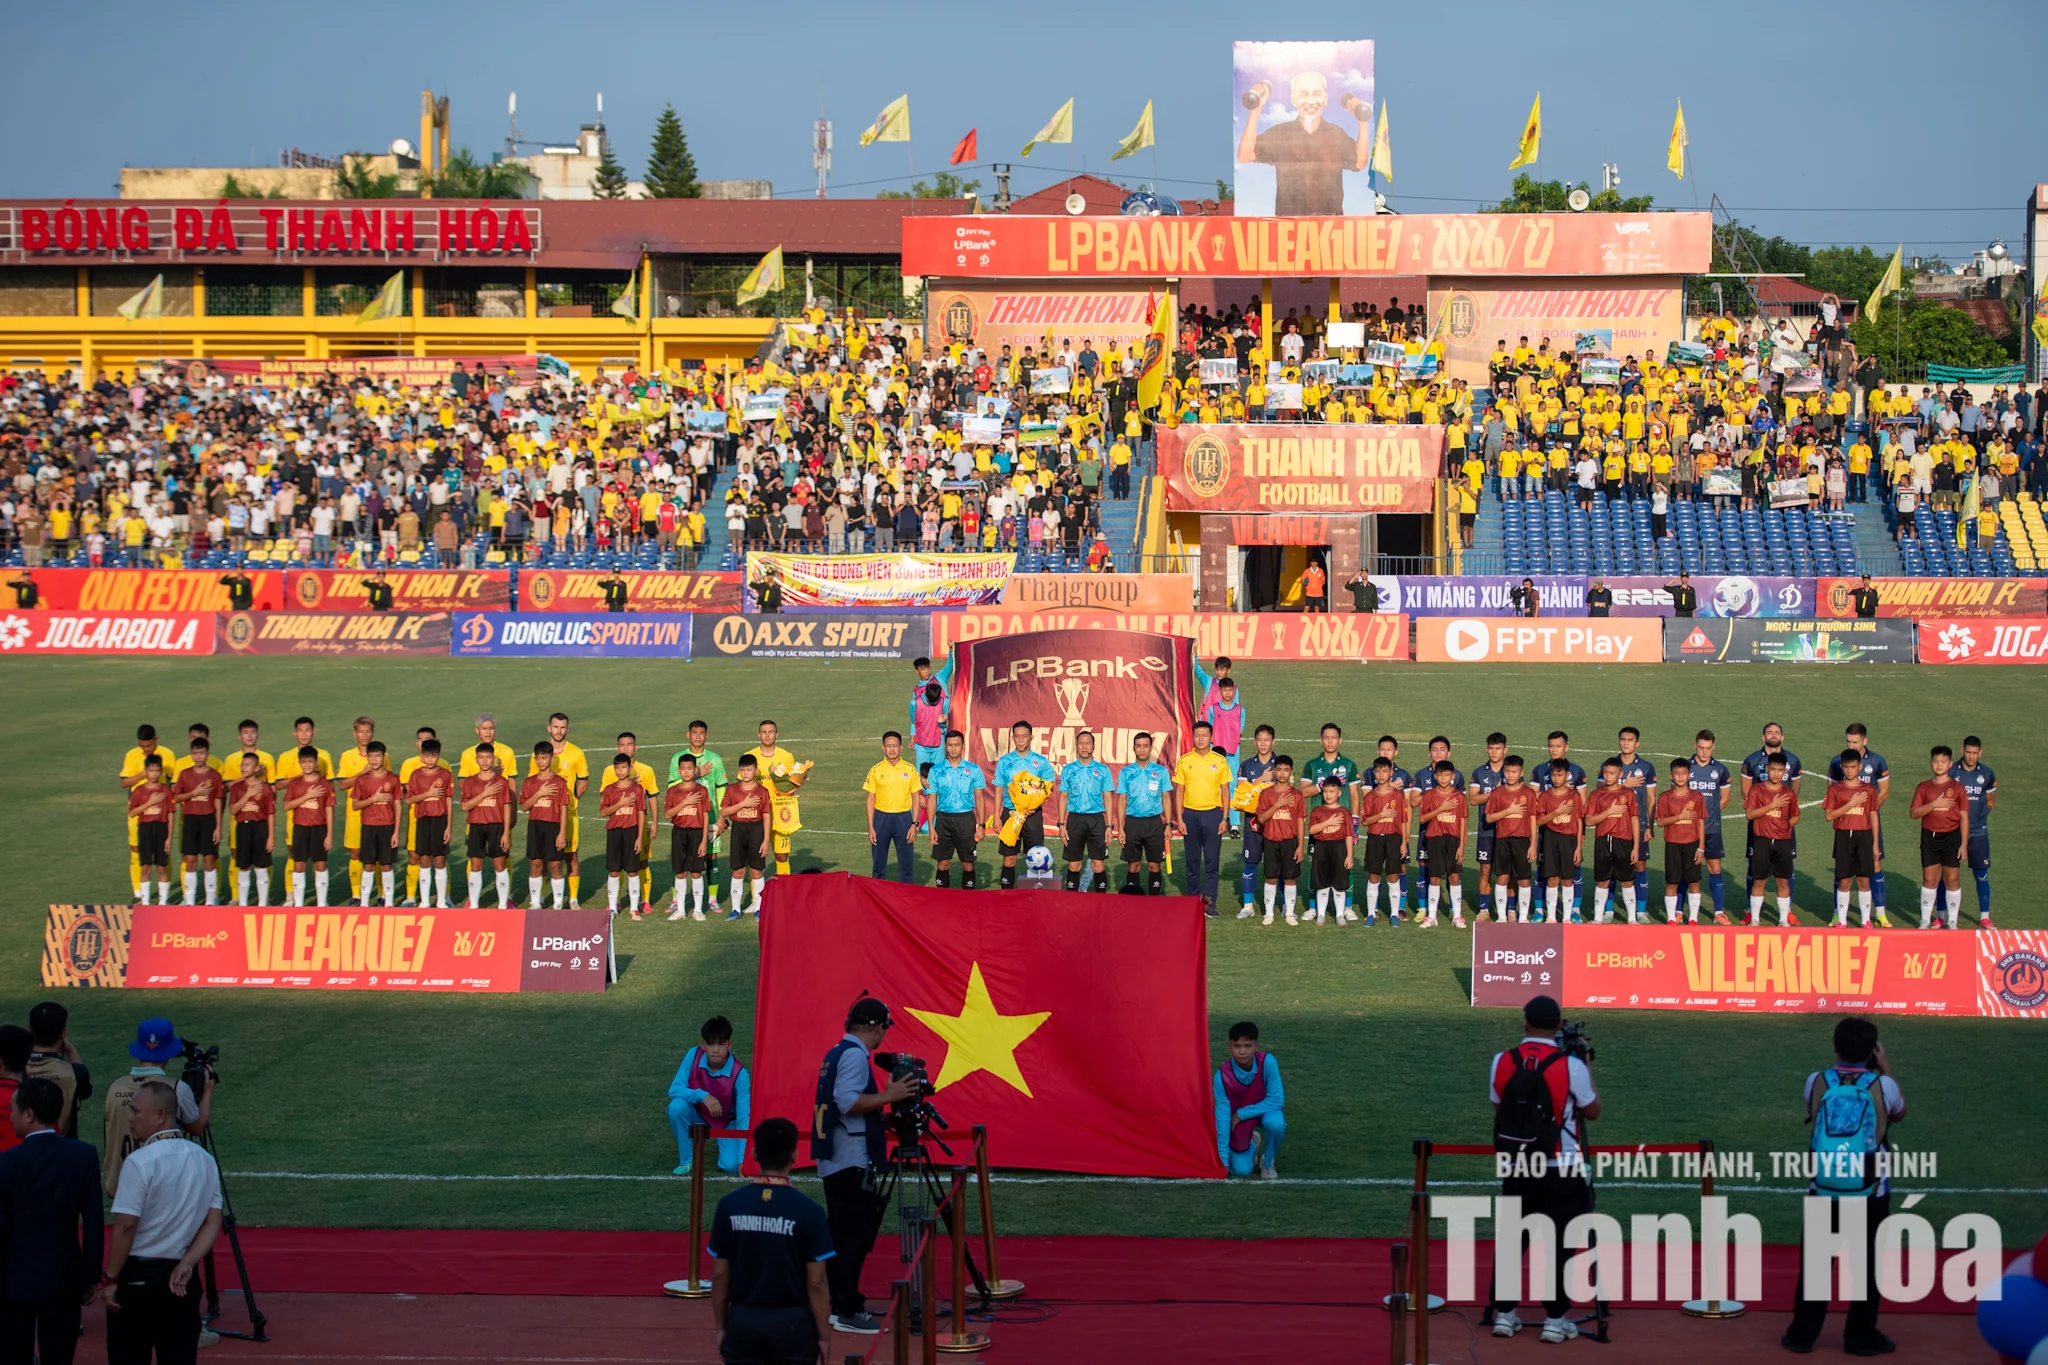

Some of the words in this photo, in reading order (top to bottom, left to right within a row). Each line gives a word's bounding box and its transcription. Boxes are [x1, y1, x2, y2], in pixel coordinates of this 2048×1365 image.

[22, 199, 149, 250] BÓNG
[175, 199, 237, 250] ĐÁ
[260, 208, 414, 251] THANH
[439, 199, 532, 251] HÓA
[954, 240, 990, 250] LPBank
[1048, 221, 1206, 272] LPBANK
[1433, 218, 1554, 269] 2026/27
[986, 294, 1076, 326] THANH
[1488, 289, 1582, 318] THANH
[1633, 289, 1673, 318] FC
[1612, 330, 1647, 339] HANH
[1239, 438, 1345, 477] THANH
[1355, 431, 1422, 477] HÓA
[1260, 483, 1352, 505] FOOTBALL
[1358, 483, 1403, 506] CLUB
[867, 558, 892, 580] VIÊN
[947, 562, 983, 579] THANH
[79, 571, 142, 611] OUR
[327, 573, 404, 598] THAH
[560, 574, 639, 598] THAH
[1013, 575, 1138, 608] Thaigroup
[1405, 586, 1421, 608] XI
[1433, 582, 1475, 608] MĂNG
[1480, 581, 1526, 608] XUÂ
[1996, 581, 2026, 606] FC
[37, 617, 199, 650] JOGARBOLA
[258, 615, 341, 640] THANH
[501, 621, 682, 646] DONGLUCSPORT.VN
[824, 622, 908, 648] SPORT
[1300, 614, 1401, 657] 2026/27
[1765, 621, 1791, 633] NGỌC
[1792, 621, 1814, 632] LINH
[1853, 621, 1877, 632] SINH
[1497, 628, 1558, 654] FPT
[1564, 628, 1633, 662] Play
[986, 656, 1139, 688] LPBank
[1698, 782, 1716, 790] SHB
[1478, 850, 1488, 860] 32
[151, 932, 216, 948] LPBank
[453, 931, 495, 957] 26/27
[532, 937, 591, 951] LPBank
[1485, 951, 1544, 965] LPBank
[1586, 952, 1653, 968] LPBank
[1904, 953, 1947, 979] 26/27
[2000, 956, 2014, 968] SHB
[2002, 992, 2031, 1006] FOOTBALL
[2031, 993, 2046, 1005] CLUB
[729, 1214, 762, 1232] THANH
[783, 1219, 796, 1236] FC
